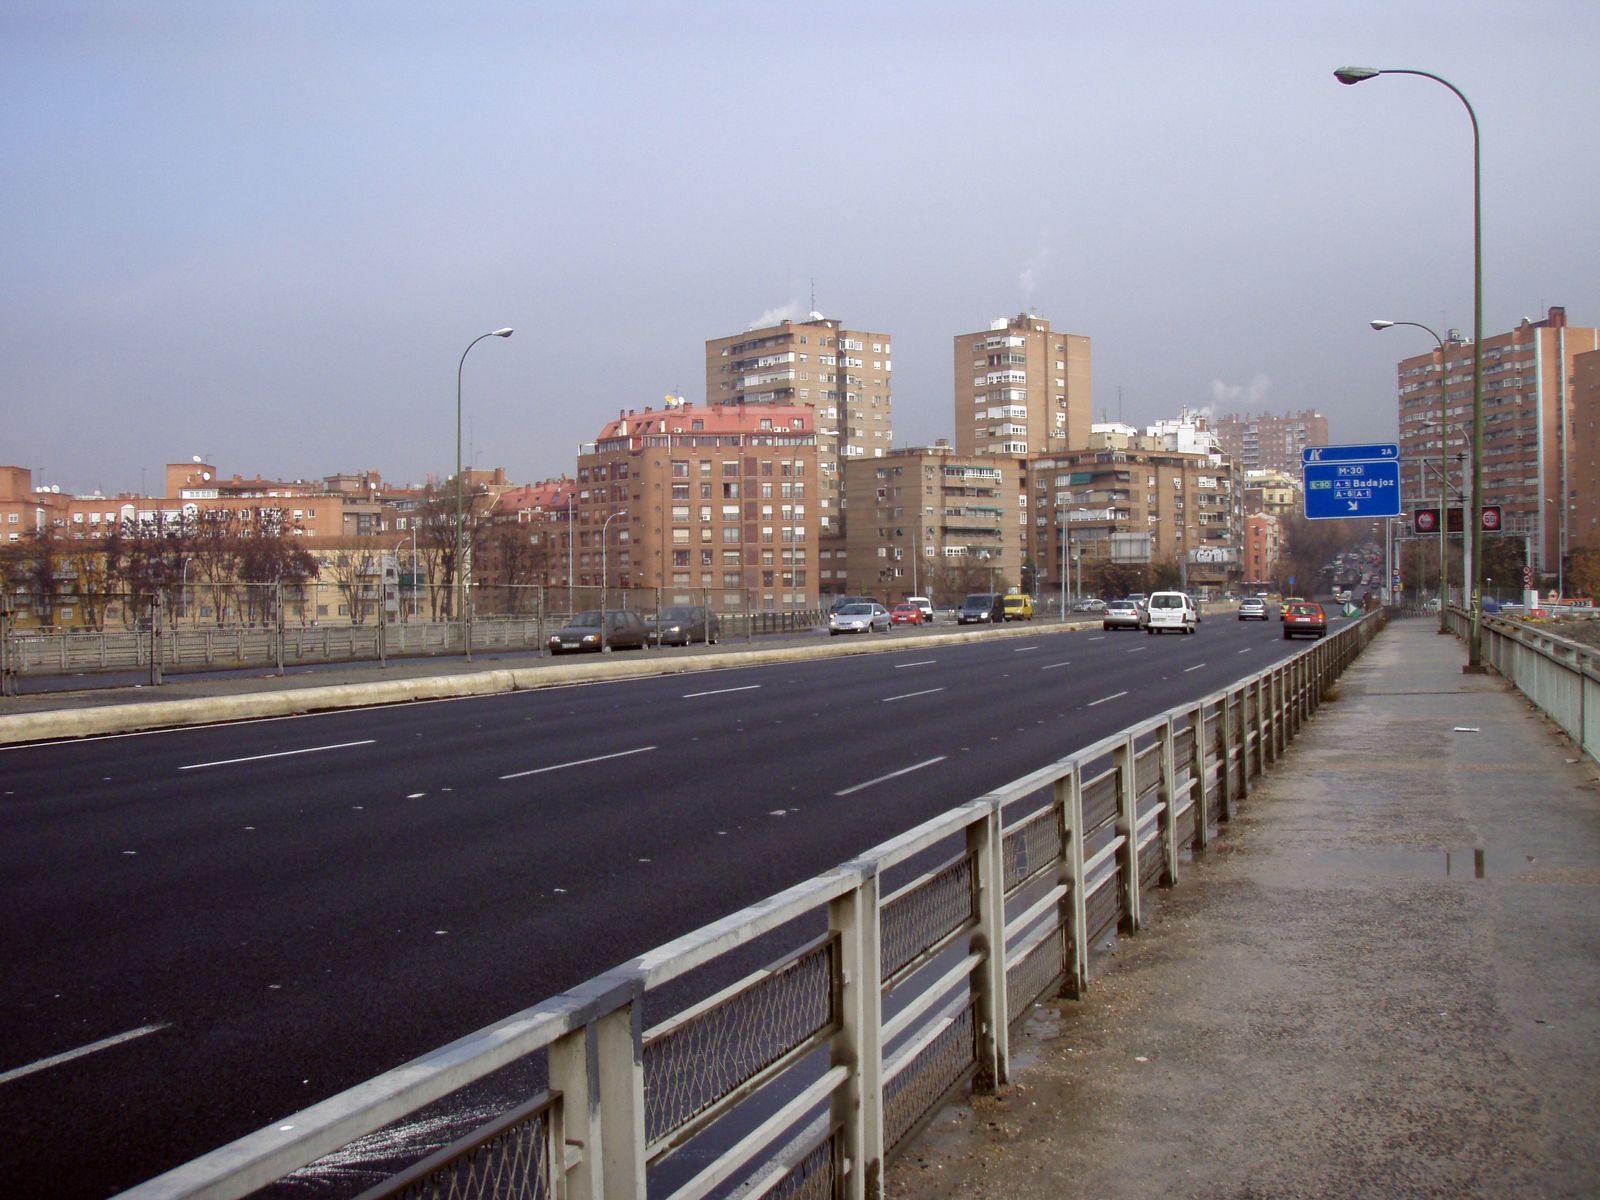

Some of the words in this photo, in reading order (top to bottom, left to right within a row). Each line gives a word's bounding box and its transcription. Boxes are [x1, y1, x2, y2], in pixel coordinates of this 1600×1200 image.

[1338, 467, 1363, 475] M-30
[1352, 478, 1394, 488] Badajoz
[1356, 489, 1370, 497] A-1
